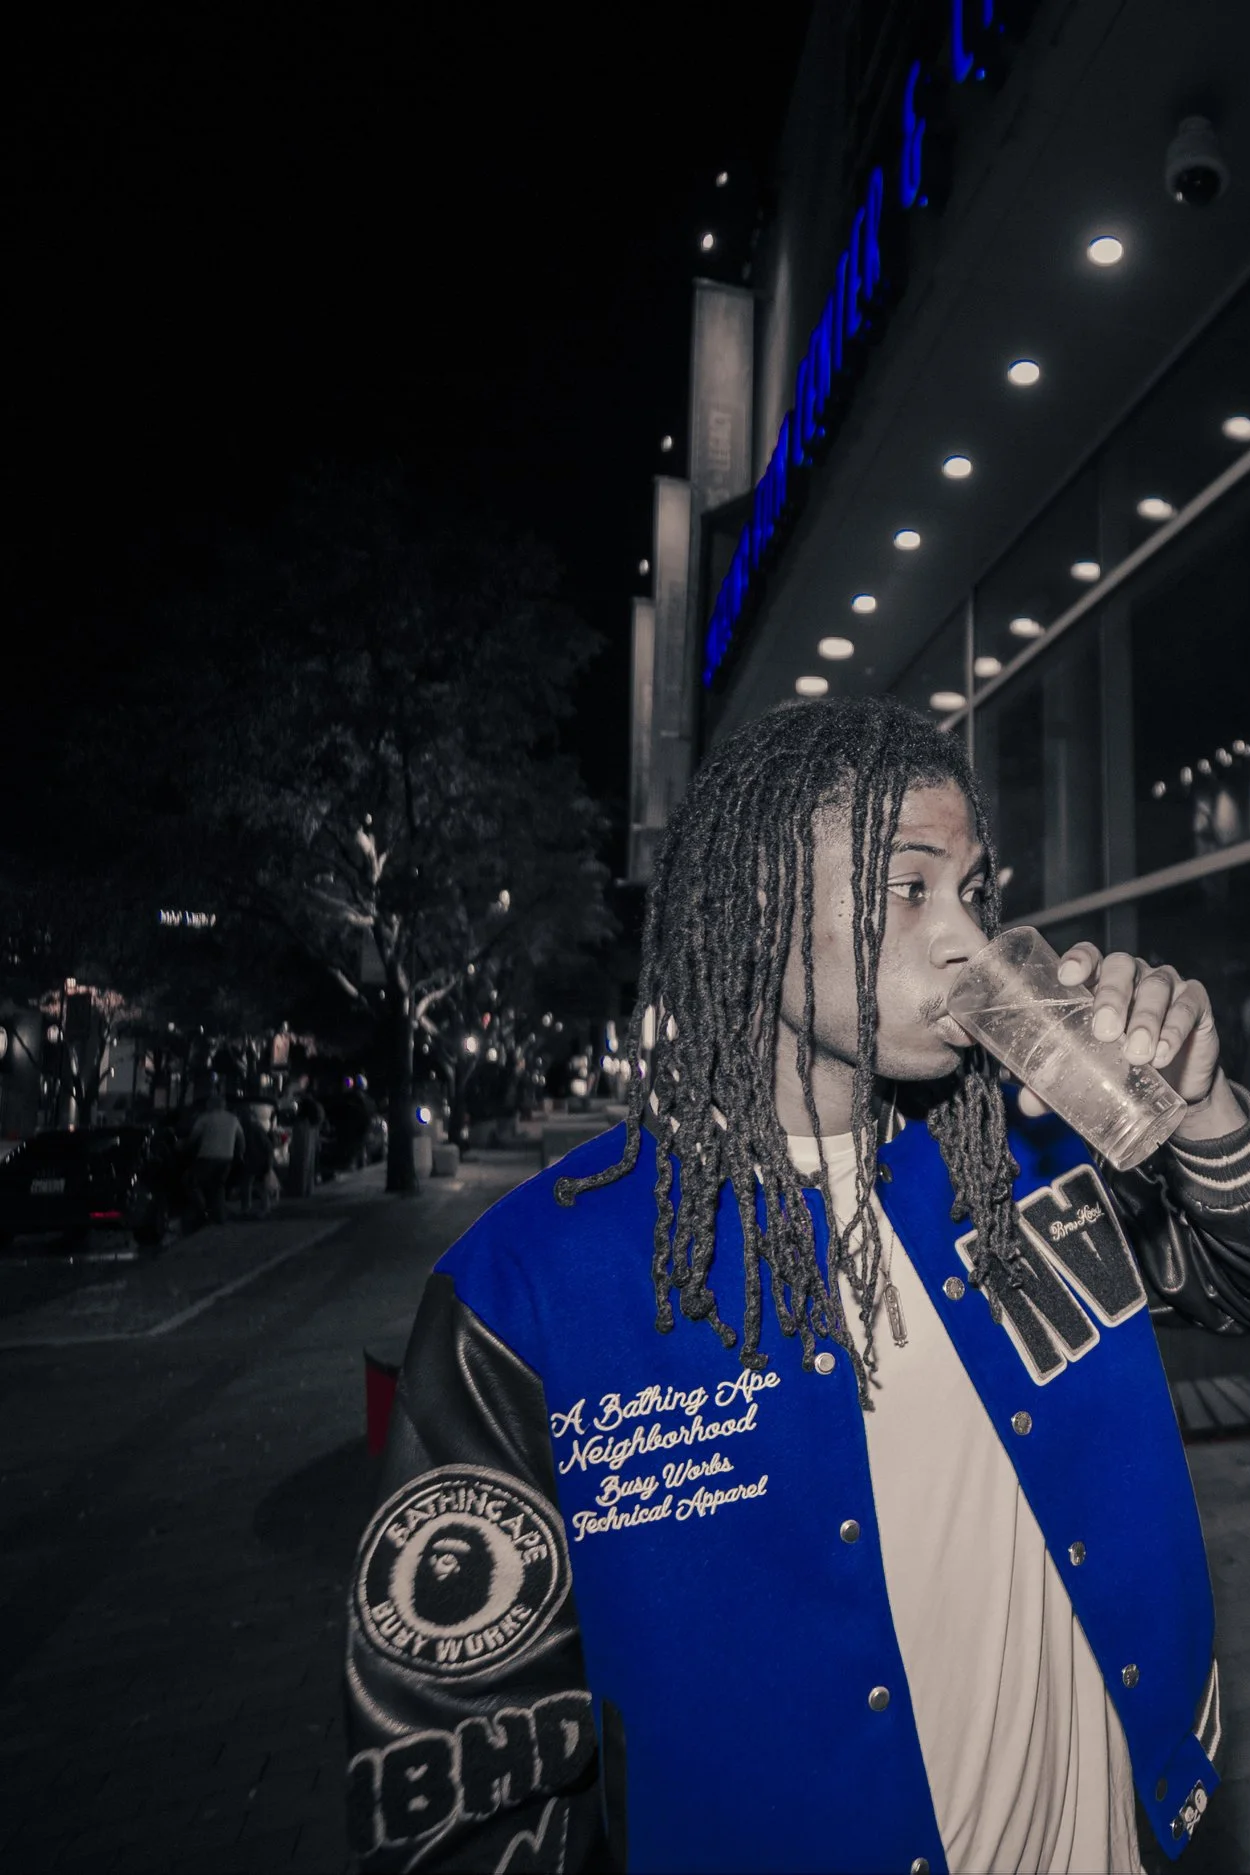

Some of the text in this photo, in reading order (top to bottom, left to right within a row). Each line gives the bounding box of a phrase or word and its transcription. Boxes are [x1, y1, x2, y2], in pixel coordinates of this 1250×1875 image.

[550, 1368, 782, 1438] A Bathing Ape
[558, 1402, 759, 1475] Neighborhood
[572, 1474, 769, 1543] Technical Apparel
[595, 1452, 735, 1507] Busy Works
[500, 1513, 548, 1566] APE
